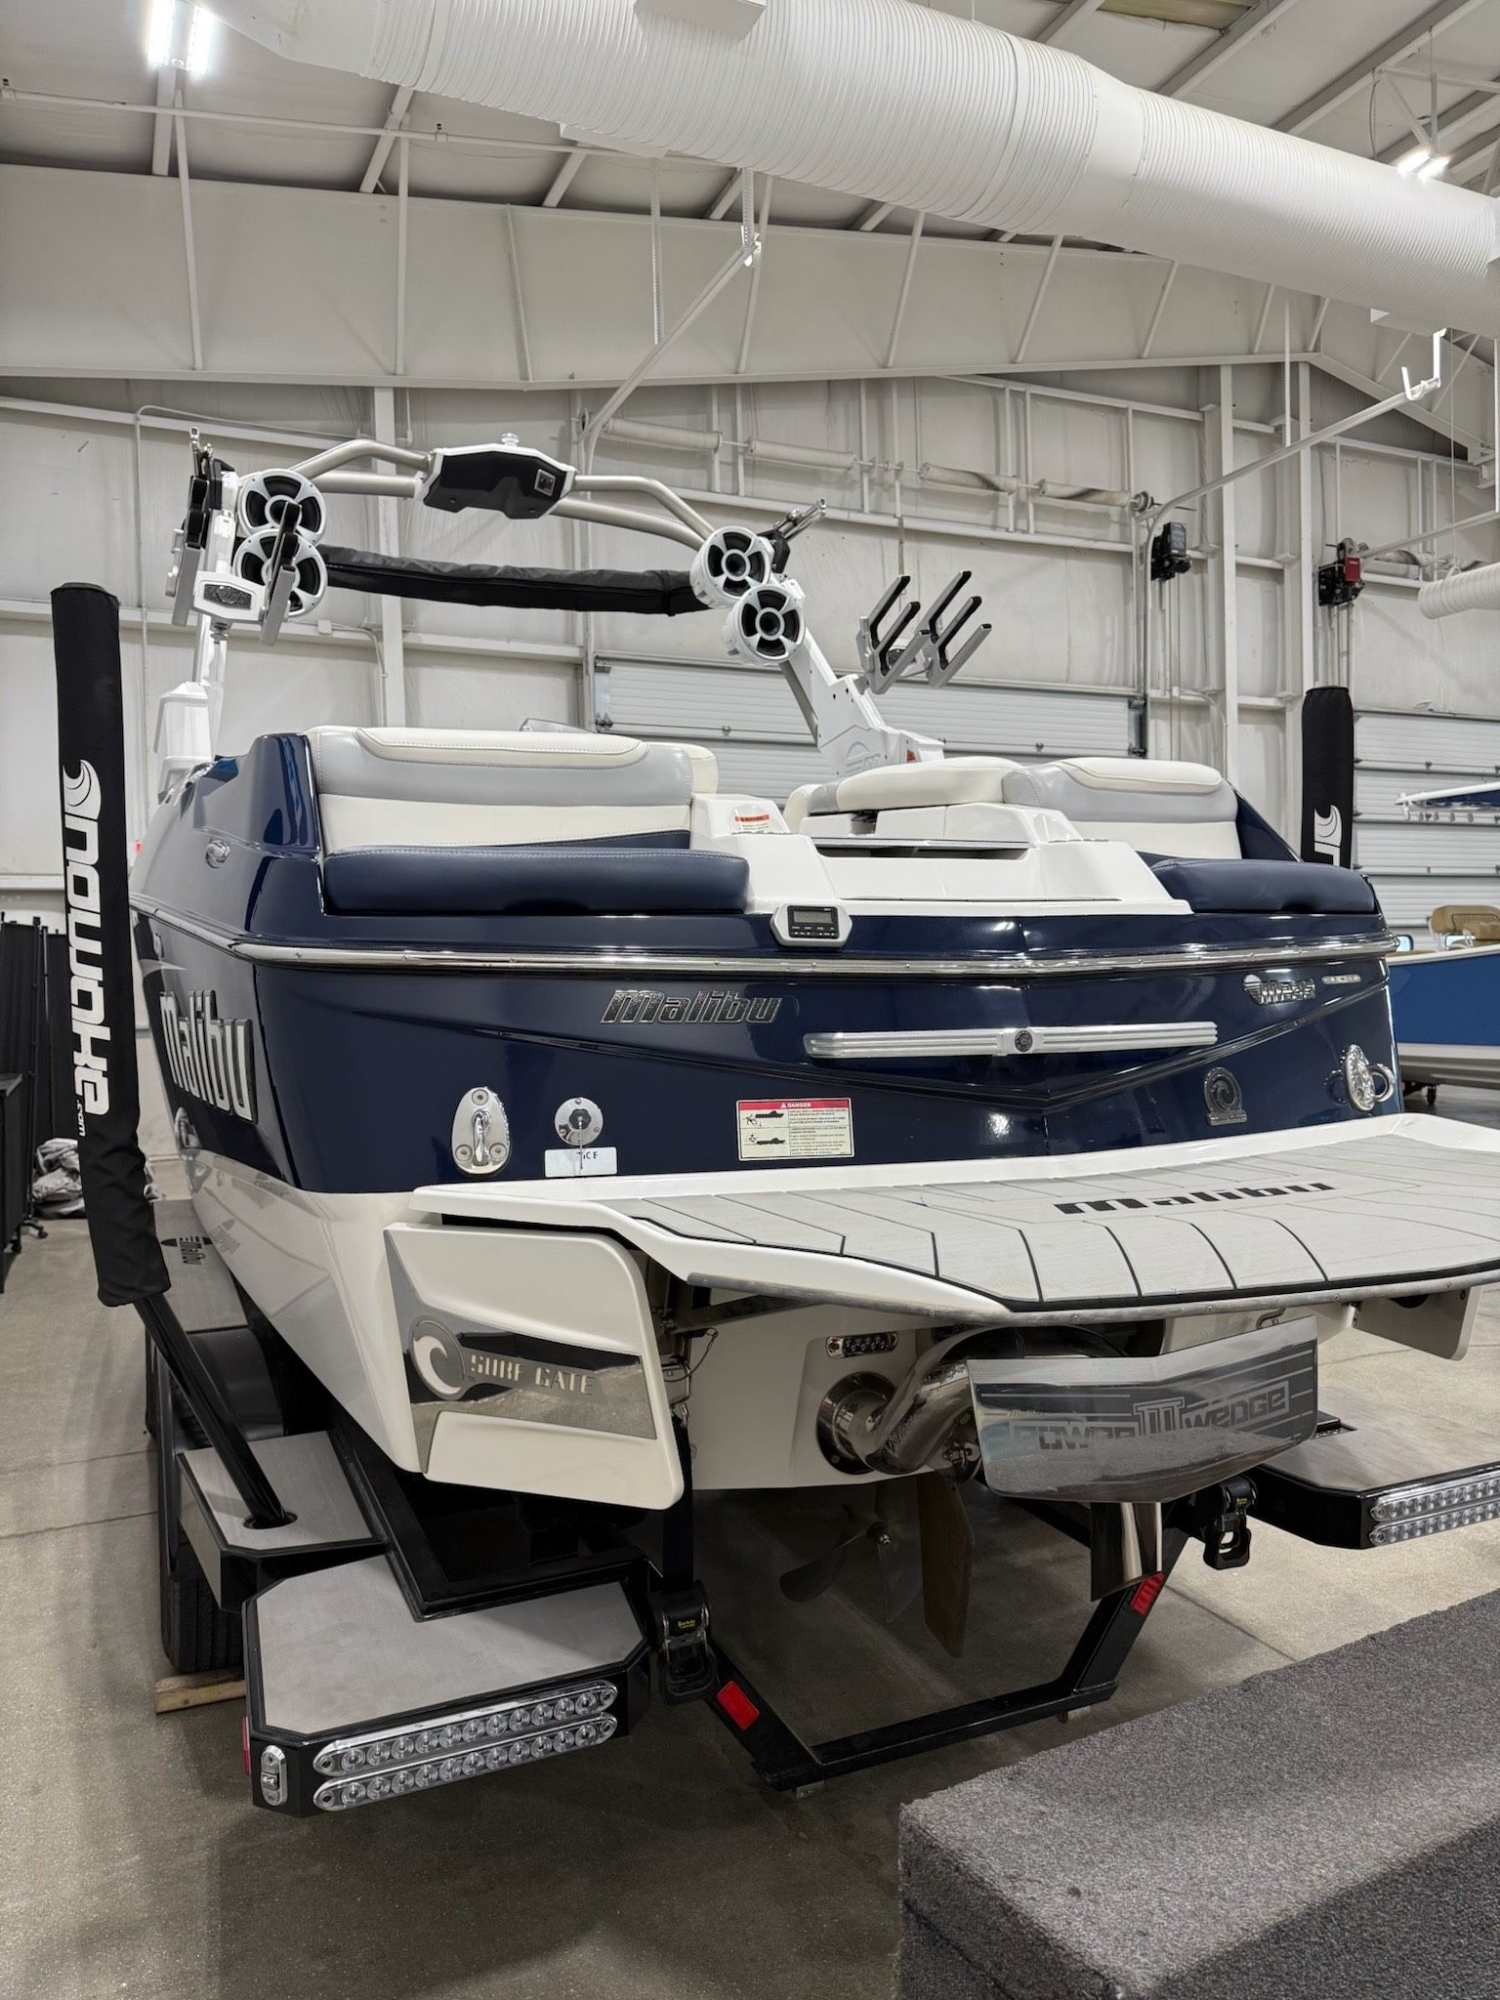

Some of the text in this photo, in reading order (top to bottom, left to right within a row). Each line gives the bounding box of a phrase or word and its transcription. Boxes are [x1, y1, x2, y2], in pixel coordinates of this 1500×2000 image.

[600, 989, 782, 1024] Malibu
[160, 991, 256, 1122] Malibu
[470, 1353, 596, 1396] SURF GATE
